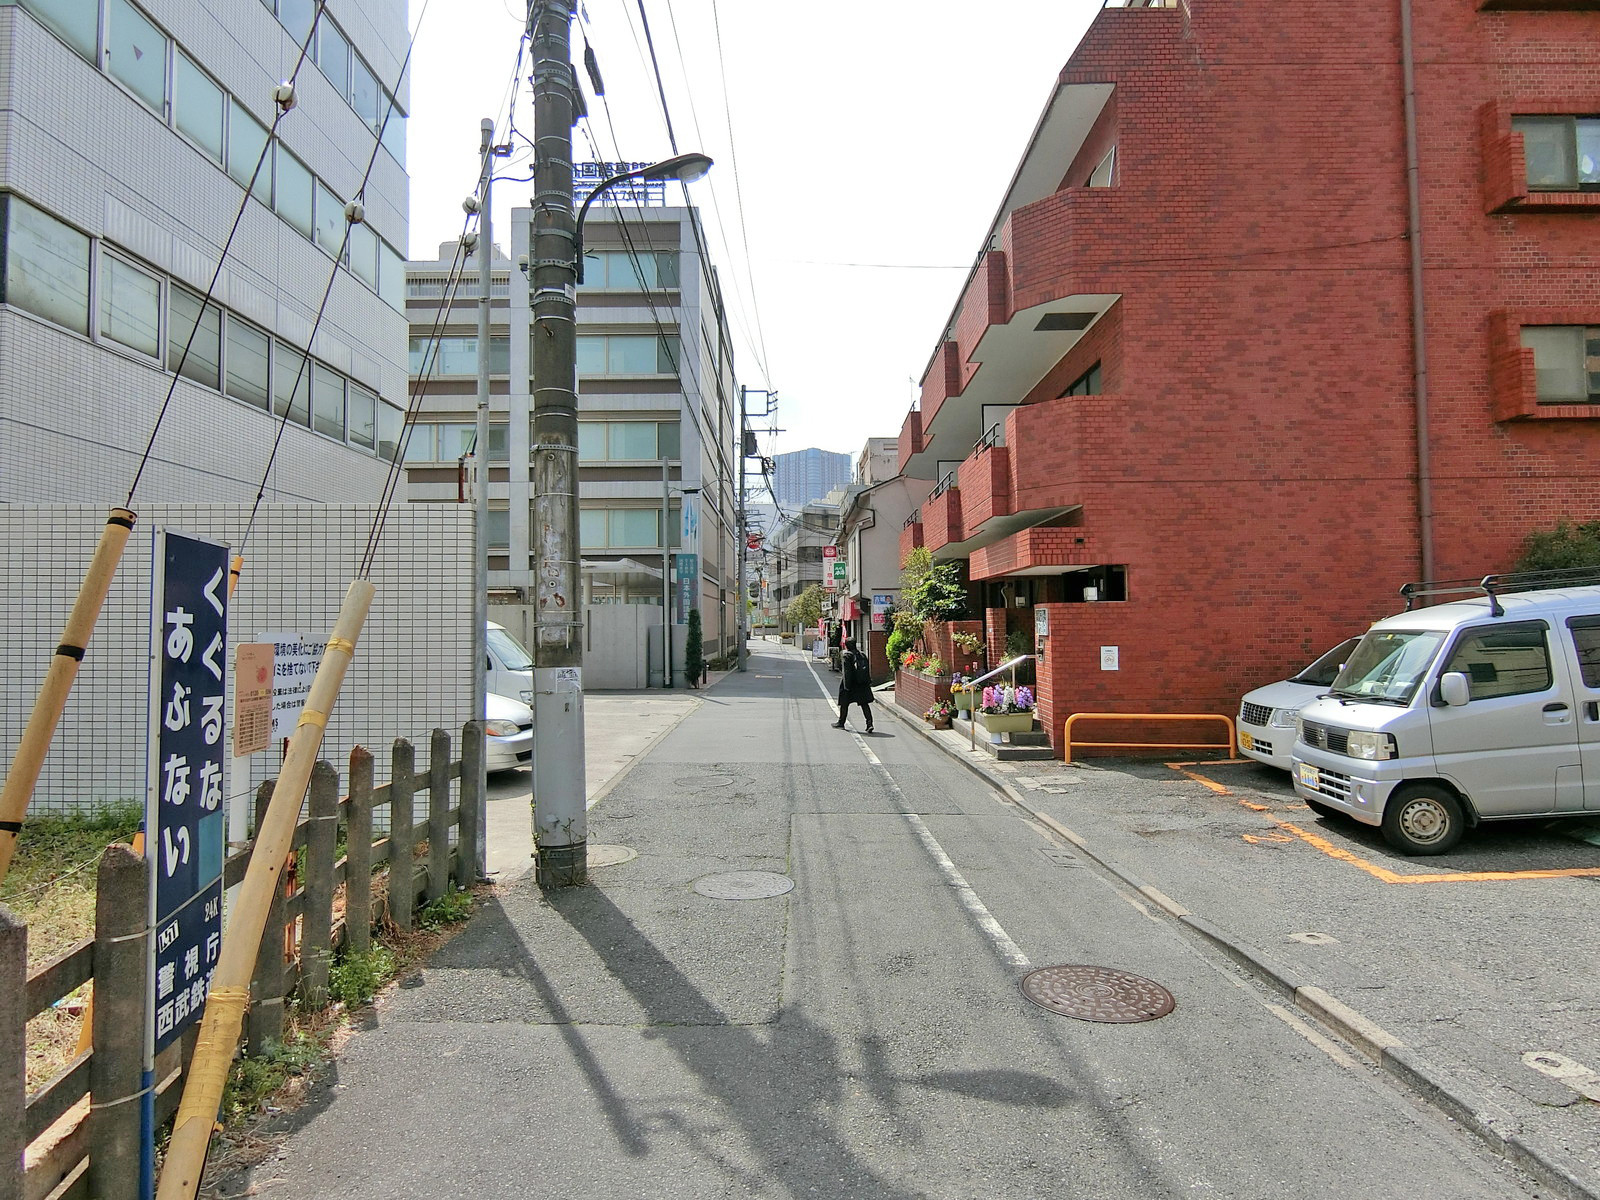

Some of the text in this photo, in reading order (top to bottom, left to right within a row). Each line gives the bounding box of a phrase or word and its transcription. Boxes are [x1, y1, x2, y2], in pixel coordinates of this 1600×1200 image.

[200, 566, 224, 811] くぐるな
[273, 661, 321, 676] ミを捨てないで下さ
[164, 606, 194, 878] あぶない
[204, 896, 219, 922] 24K
[158, 931, 220, 1000] 警視庁
